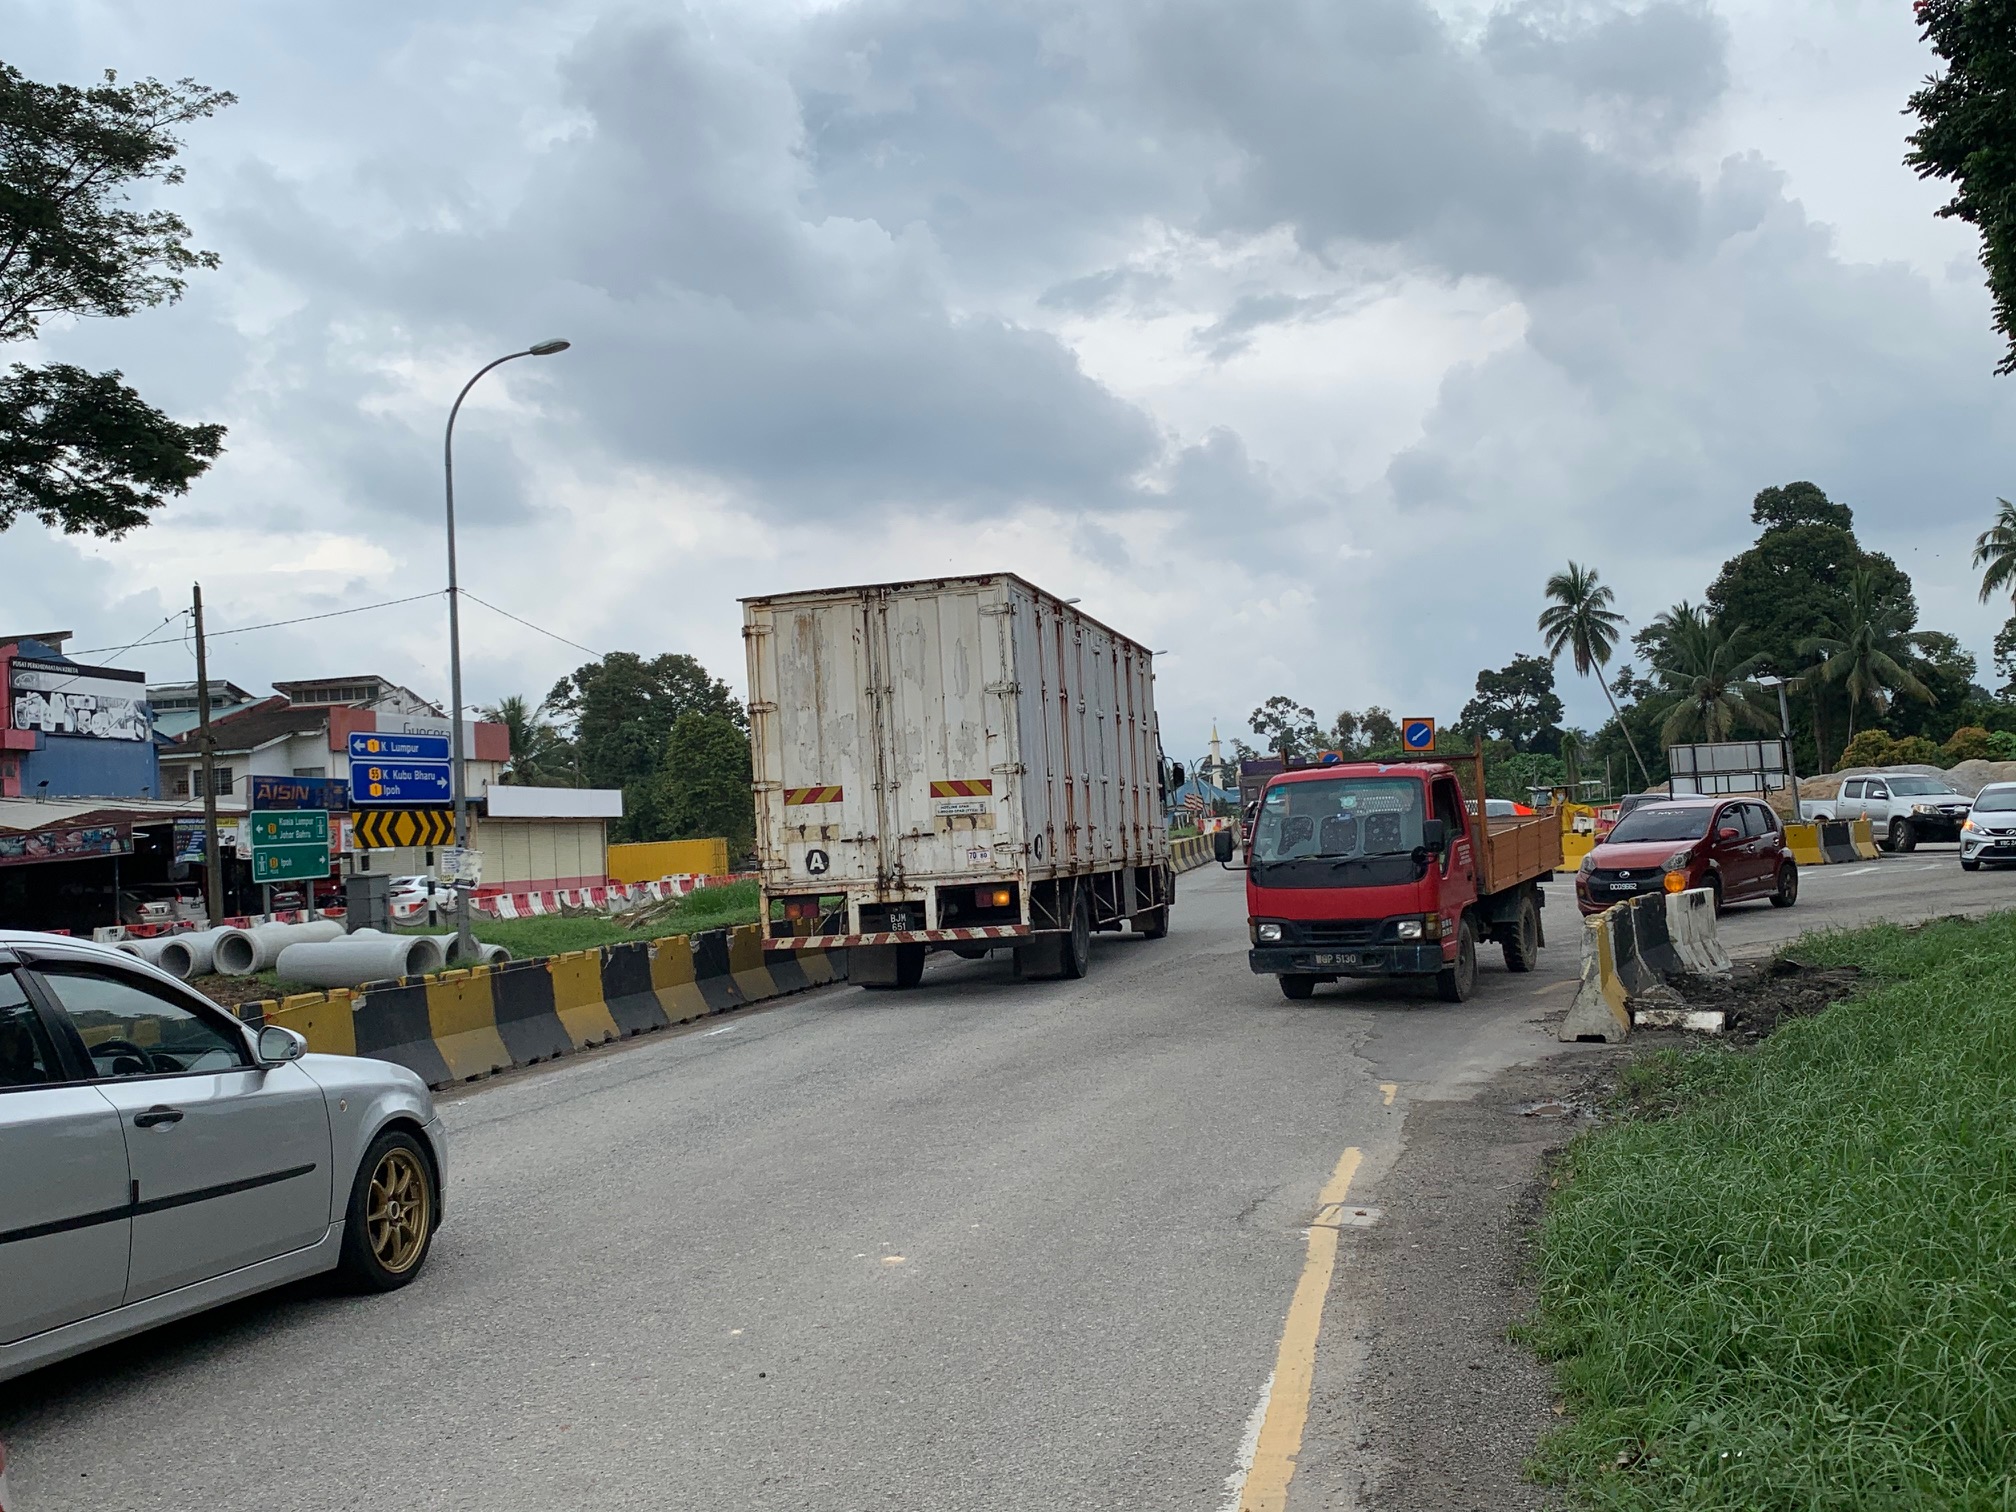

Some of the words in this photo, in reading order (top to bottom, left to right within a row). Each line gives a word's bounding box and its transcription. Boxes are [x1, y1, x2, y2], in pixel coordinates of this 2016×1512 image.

[12, 660, 27, 668] PUSAT
[380, 741, 389, 751] K.
[390, 742, 419, 754] Lumpur
[371, 769, 380, 779] 55
[382, 769, 390, 780] K.
[392, 770, 412, 780] Kubu
[414, 770, 436, 780] Bharu
[256, 784, 310, 800] AISIN
[383, 785, 401, 796] Ipoh
[278, 817, 294, 826] Kuala
[295, 816, 314, 828] Lumpur
[279, 830, 295, 839] Johor
[809, 852, 826, 871] A
[968, 852, 978, 860] 70
[280, 857, 292, 868] Ipoh
[890, 913, 907, 923] BJM
[892, 923, 907, 932] 651
[1335, 954, 1357, 964] 5130
